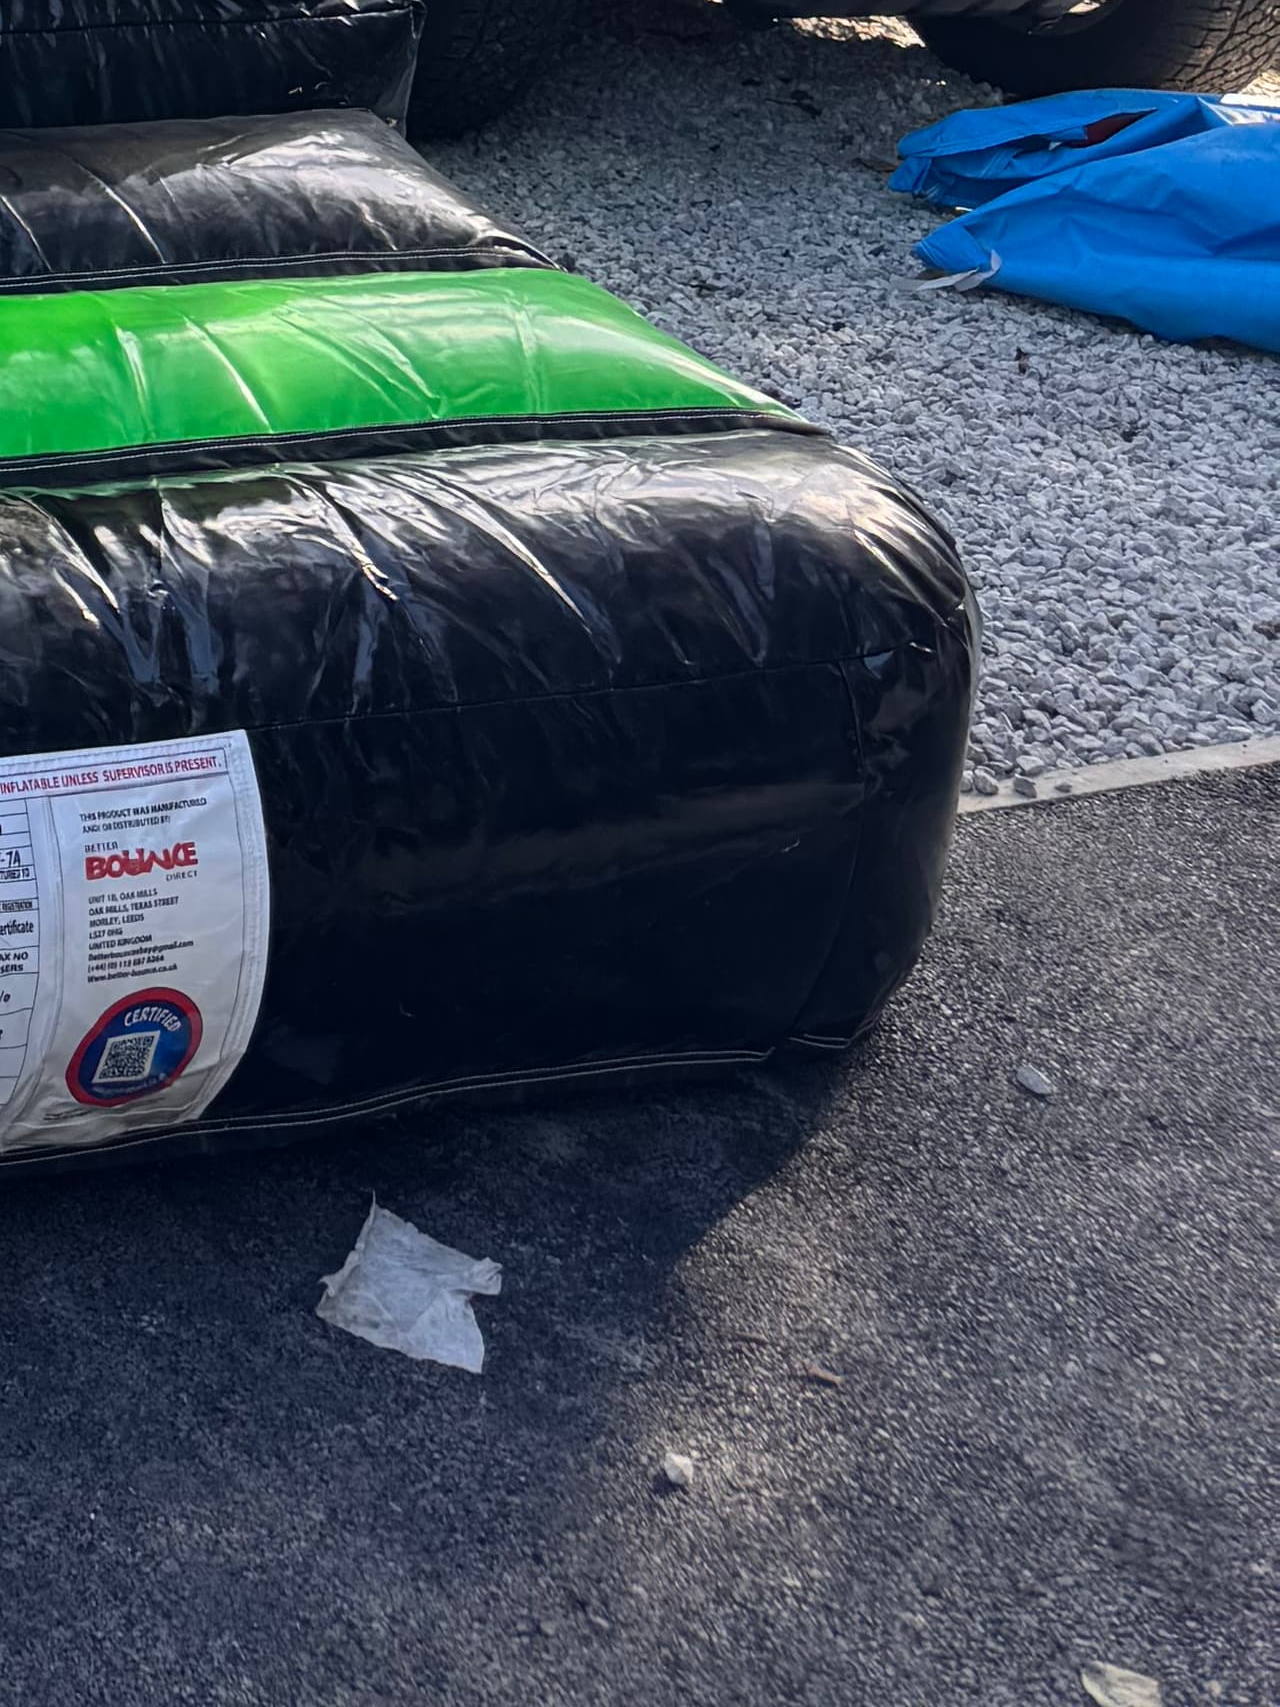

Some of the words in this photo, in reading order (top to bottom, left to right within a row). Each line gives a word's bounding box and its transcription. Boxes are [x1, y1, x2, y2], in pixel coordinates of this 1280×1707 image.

[0, 776, 59, 795] INFLATABLE
[61, 771, 99, 788] UNLESS
[175, 756, 222, 772] PRESENT.
[80, 813, 96, 822] THIS
[97, 808, 131, 820] PRODUCT
[133, 806, 150, 815] WAS
[151, 797, 207, 813] MANUFACTURED
[84, 841, 118, 853] BETTER
[85, 842, 198, 880] BOUNCE
[166, 870, 198, 882] DIRECT
[122, 913, 144, 924] LEEDS
[89, 940, 116, 950] UNITED
[117, 934, 152, 946] KINGDOM
[13, 951, 29, 961] NO
[123, 1006, 182, 1032] CERTIFIED
